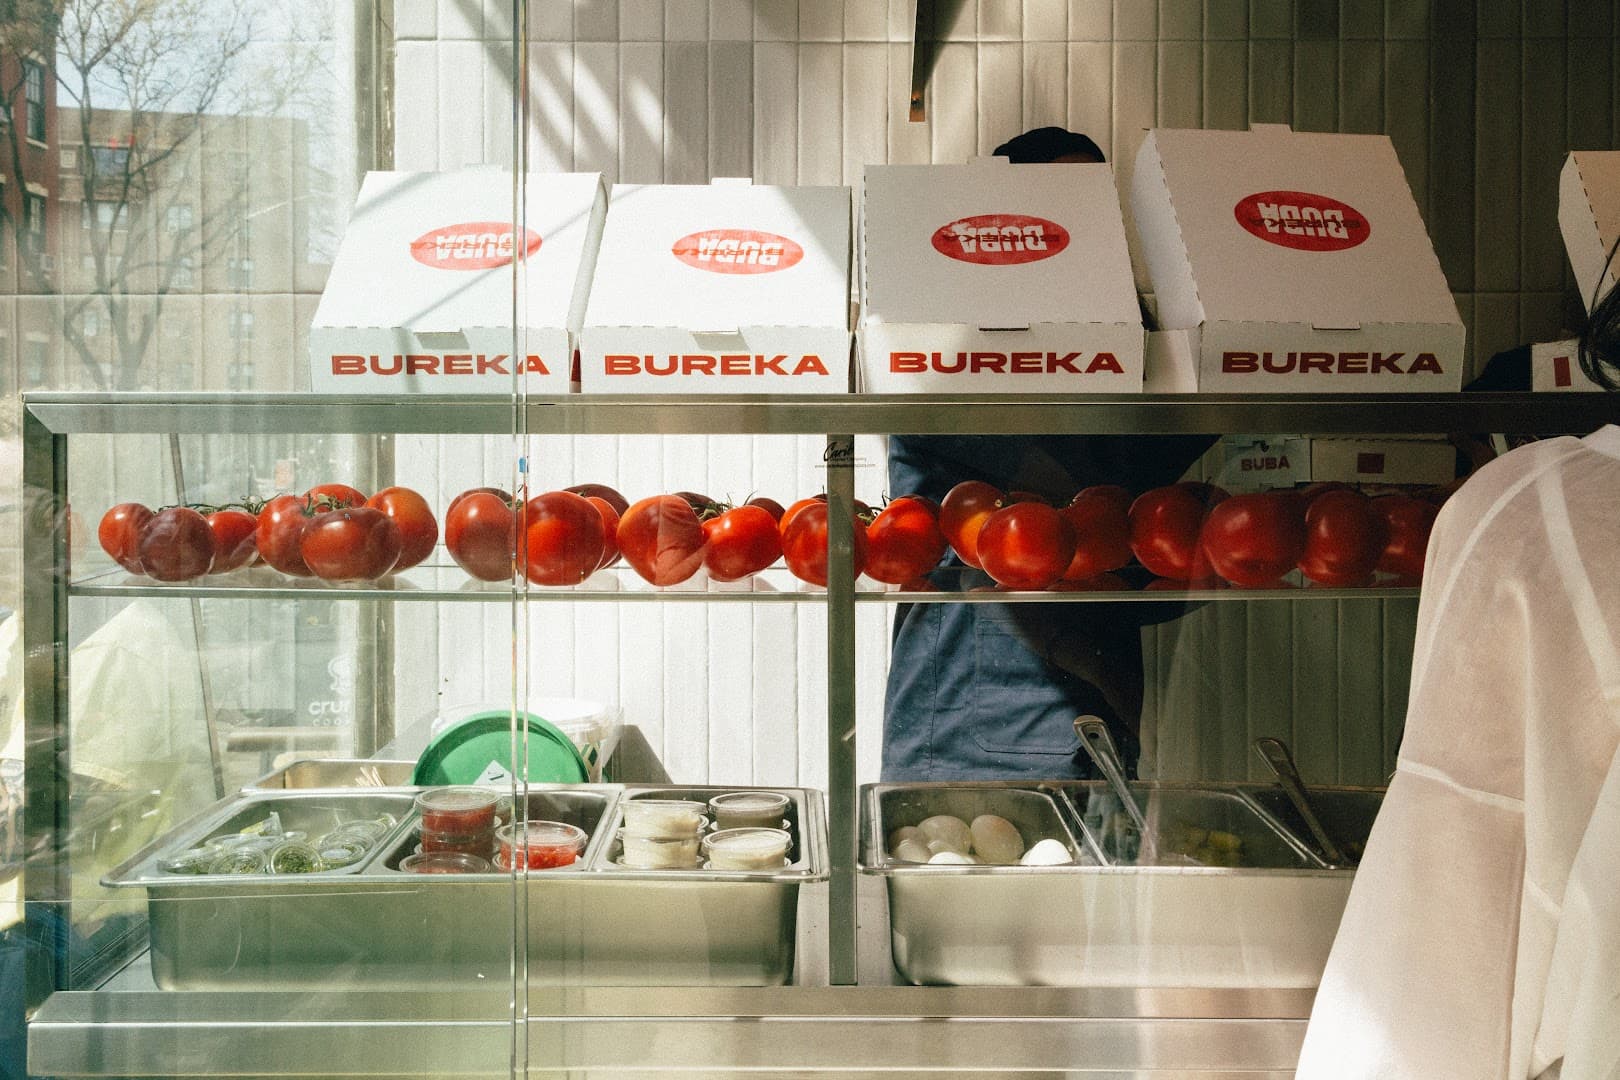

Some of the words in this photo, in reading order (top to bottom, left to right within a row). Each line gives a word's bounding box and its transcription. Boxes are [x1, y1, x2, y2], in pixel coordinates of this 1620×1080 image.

[331, 355, 550, 375] BUREKA
[605, 355, 829, 375] BUREKA
[890, 351, 1125, 374] BUREKA
[1222, 352, 1443, 374] BUREKA
[1241, 456, 1291, 472] BUBA
